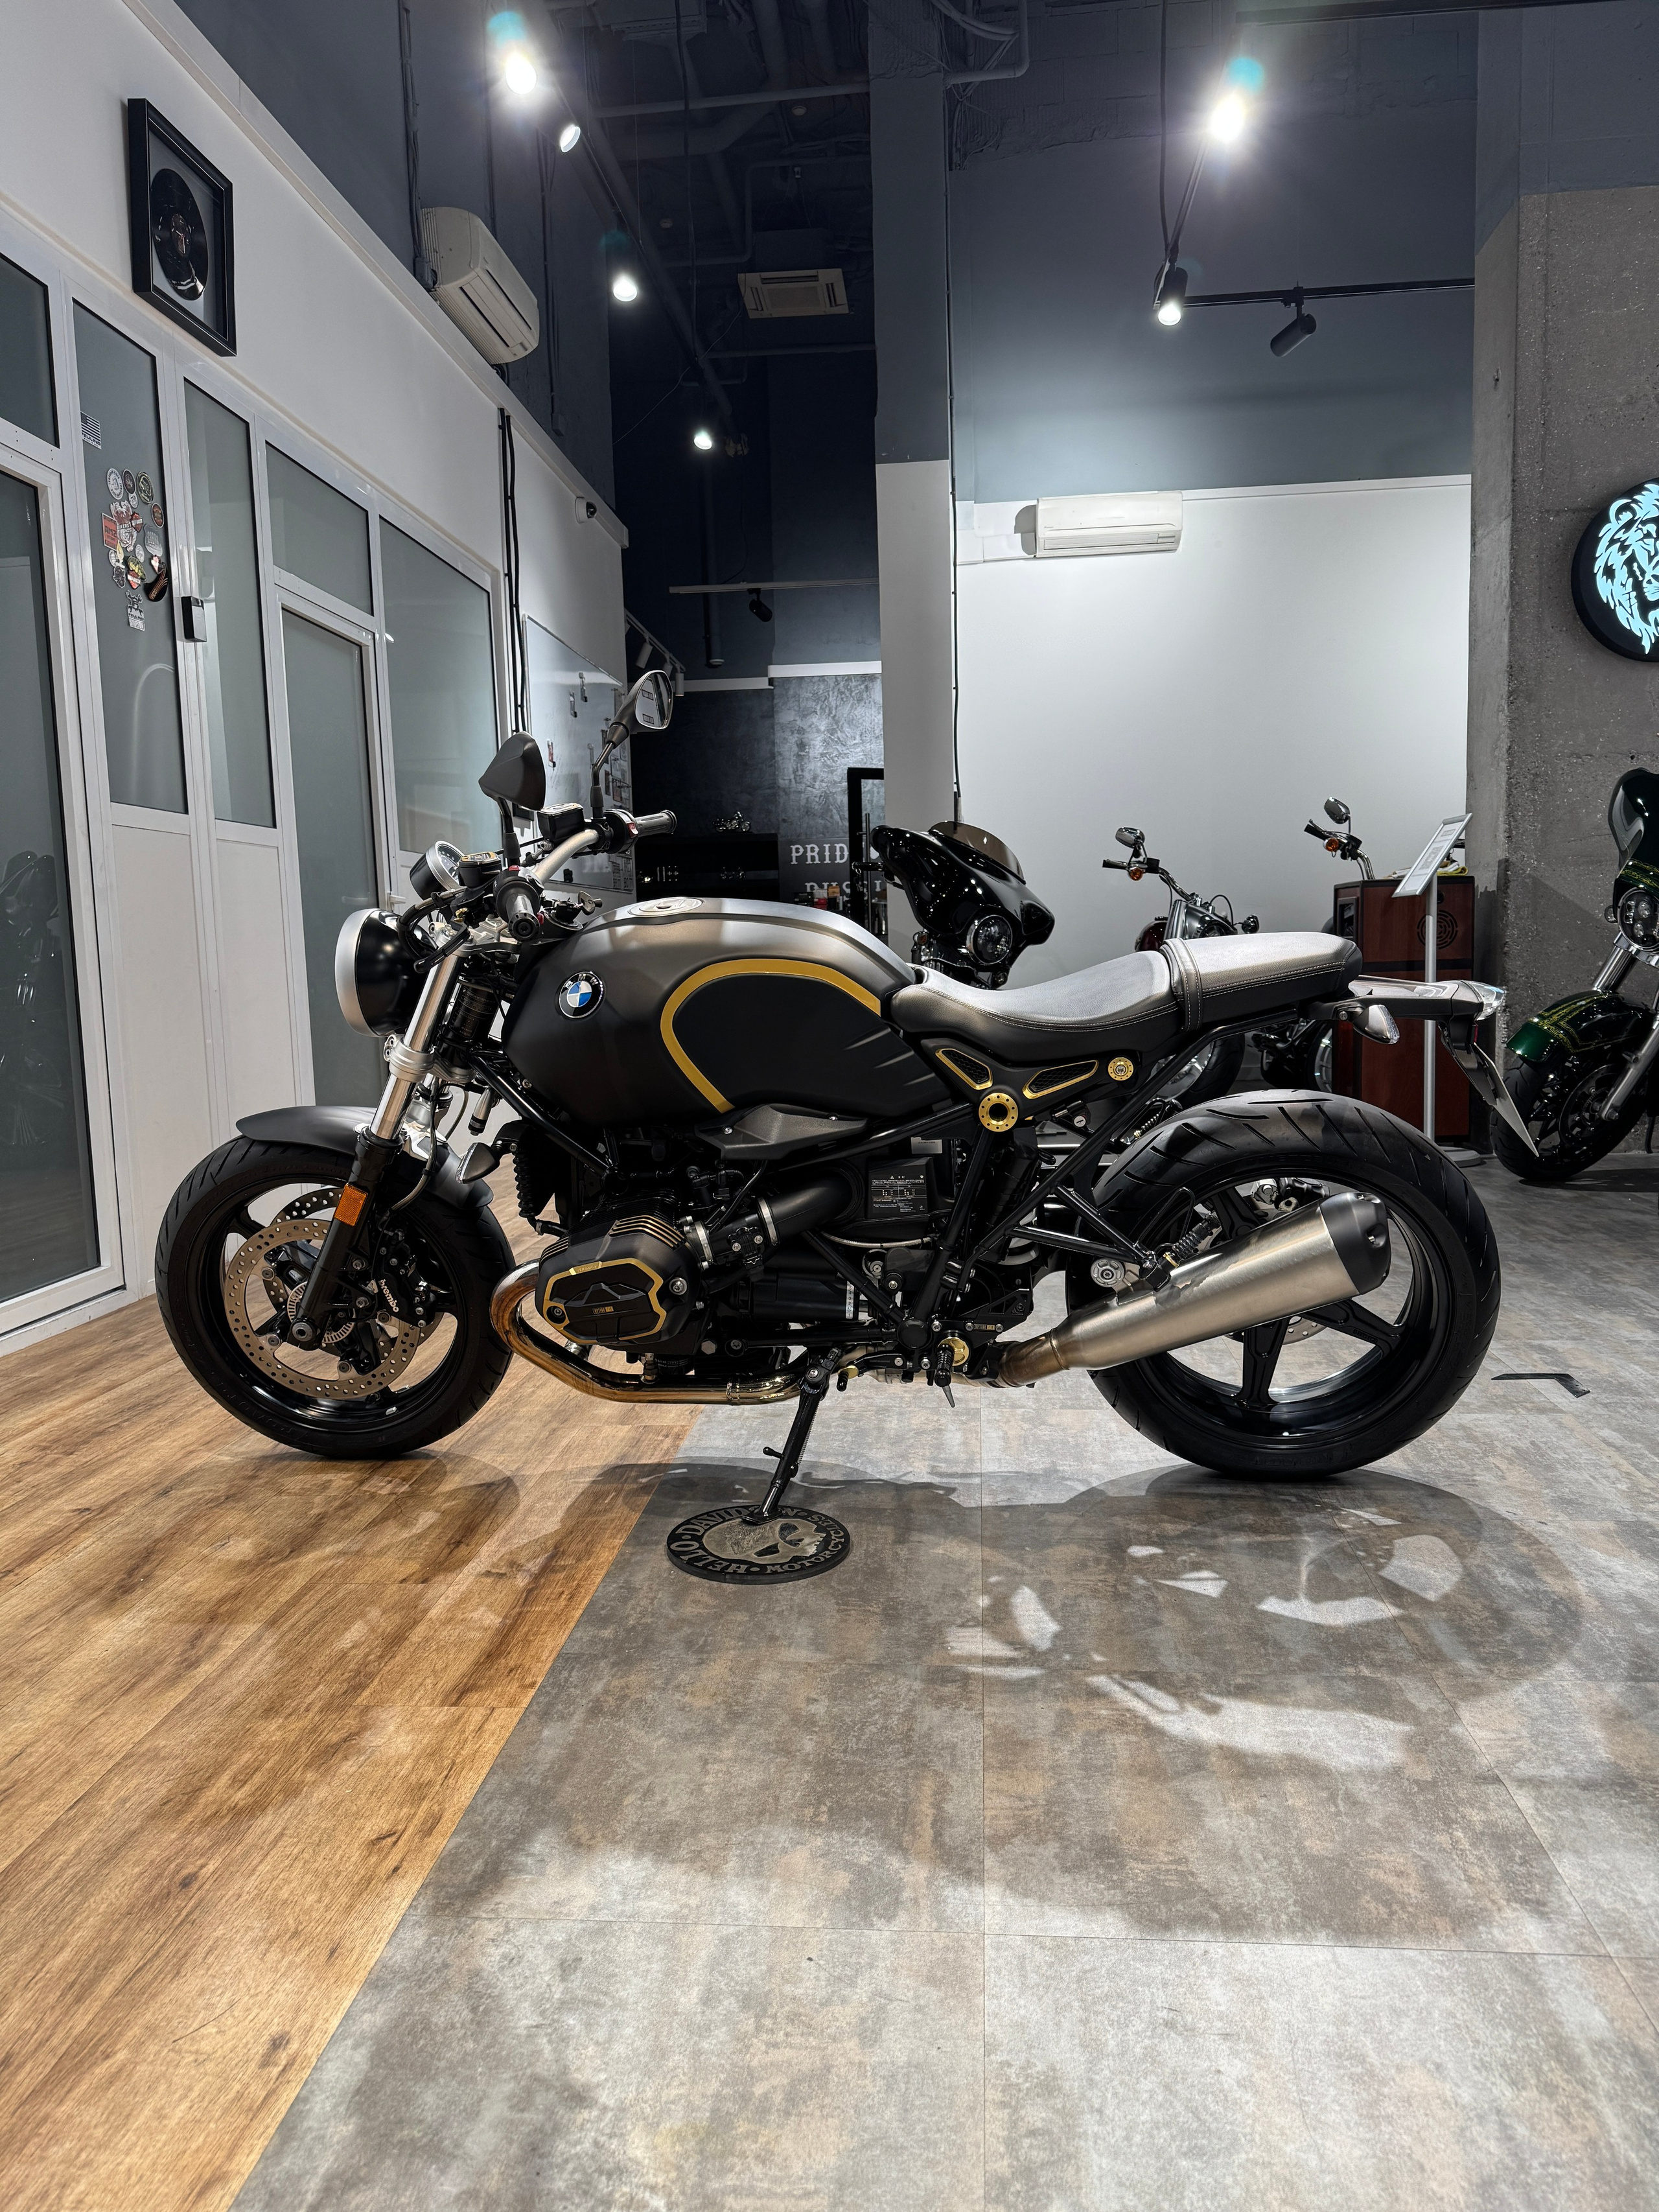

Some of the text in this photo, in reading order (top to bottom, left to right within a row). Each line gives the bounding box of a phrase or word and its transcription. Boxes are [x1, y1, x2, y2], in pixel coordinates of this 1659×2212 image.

[790, 843, 864, 864] PRID
[564, 973, 598, 988] BMW
[378, 1279, 399, 1312] brembo
[669, 1506, 799, 1574] HELLO DAVIDN
[766, 1514, 845, 1574] MOTORCYCLES
